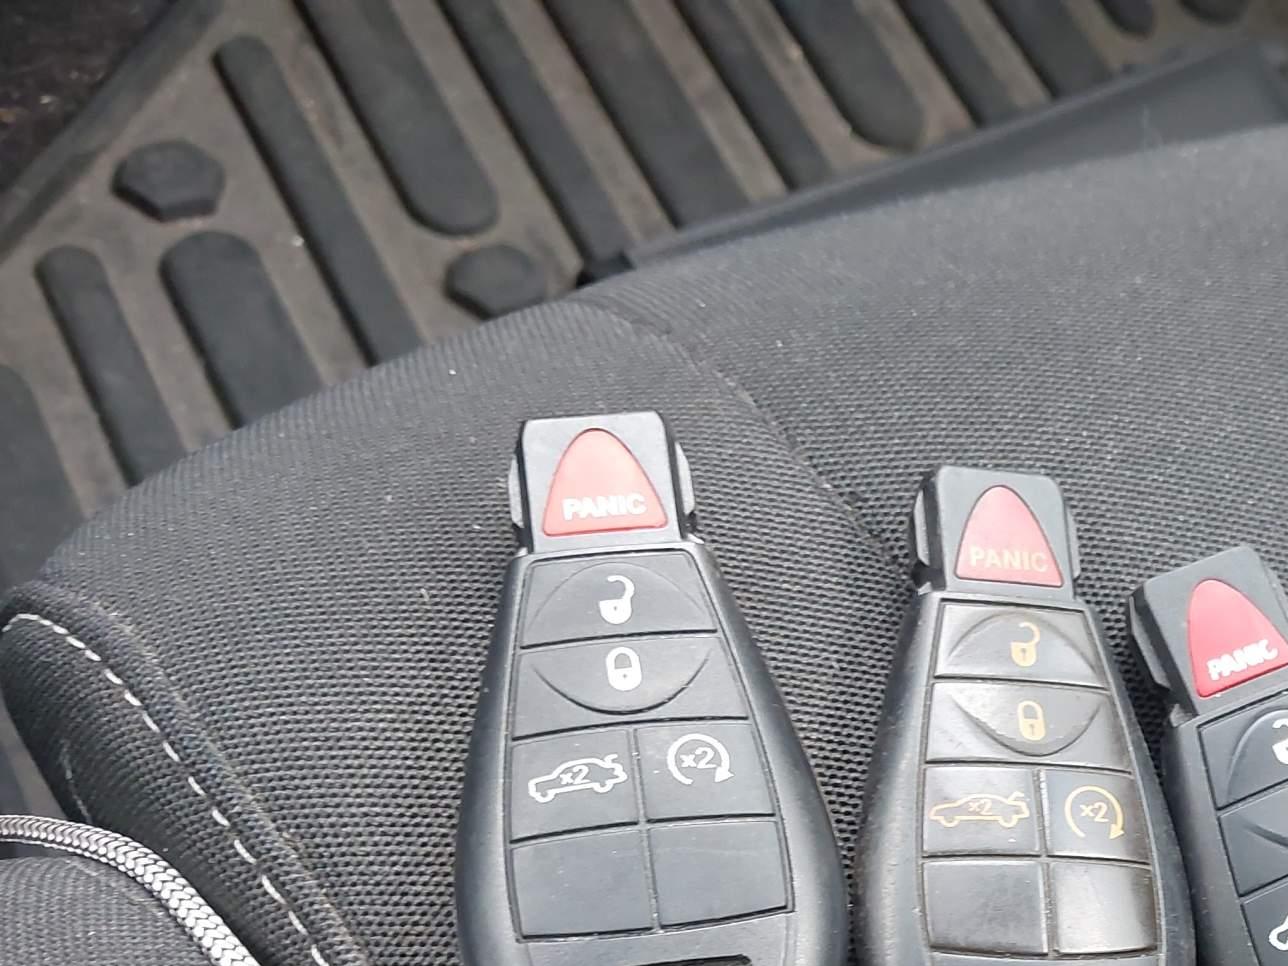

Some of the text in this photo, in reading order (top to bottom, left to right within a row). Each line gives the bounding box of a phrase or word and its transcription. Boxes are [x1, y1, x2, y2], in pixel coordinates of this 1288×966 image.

[562, 492, 648, 521] PANIC
[969, 544, 1049, 573] PANIC
[1207, 639, 1279, 681] PANIC
[679, 749, 717, 769] x2
[1080, 801, 1110, 823] x2
